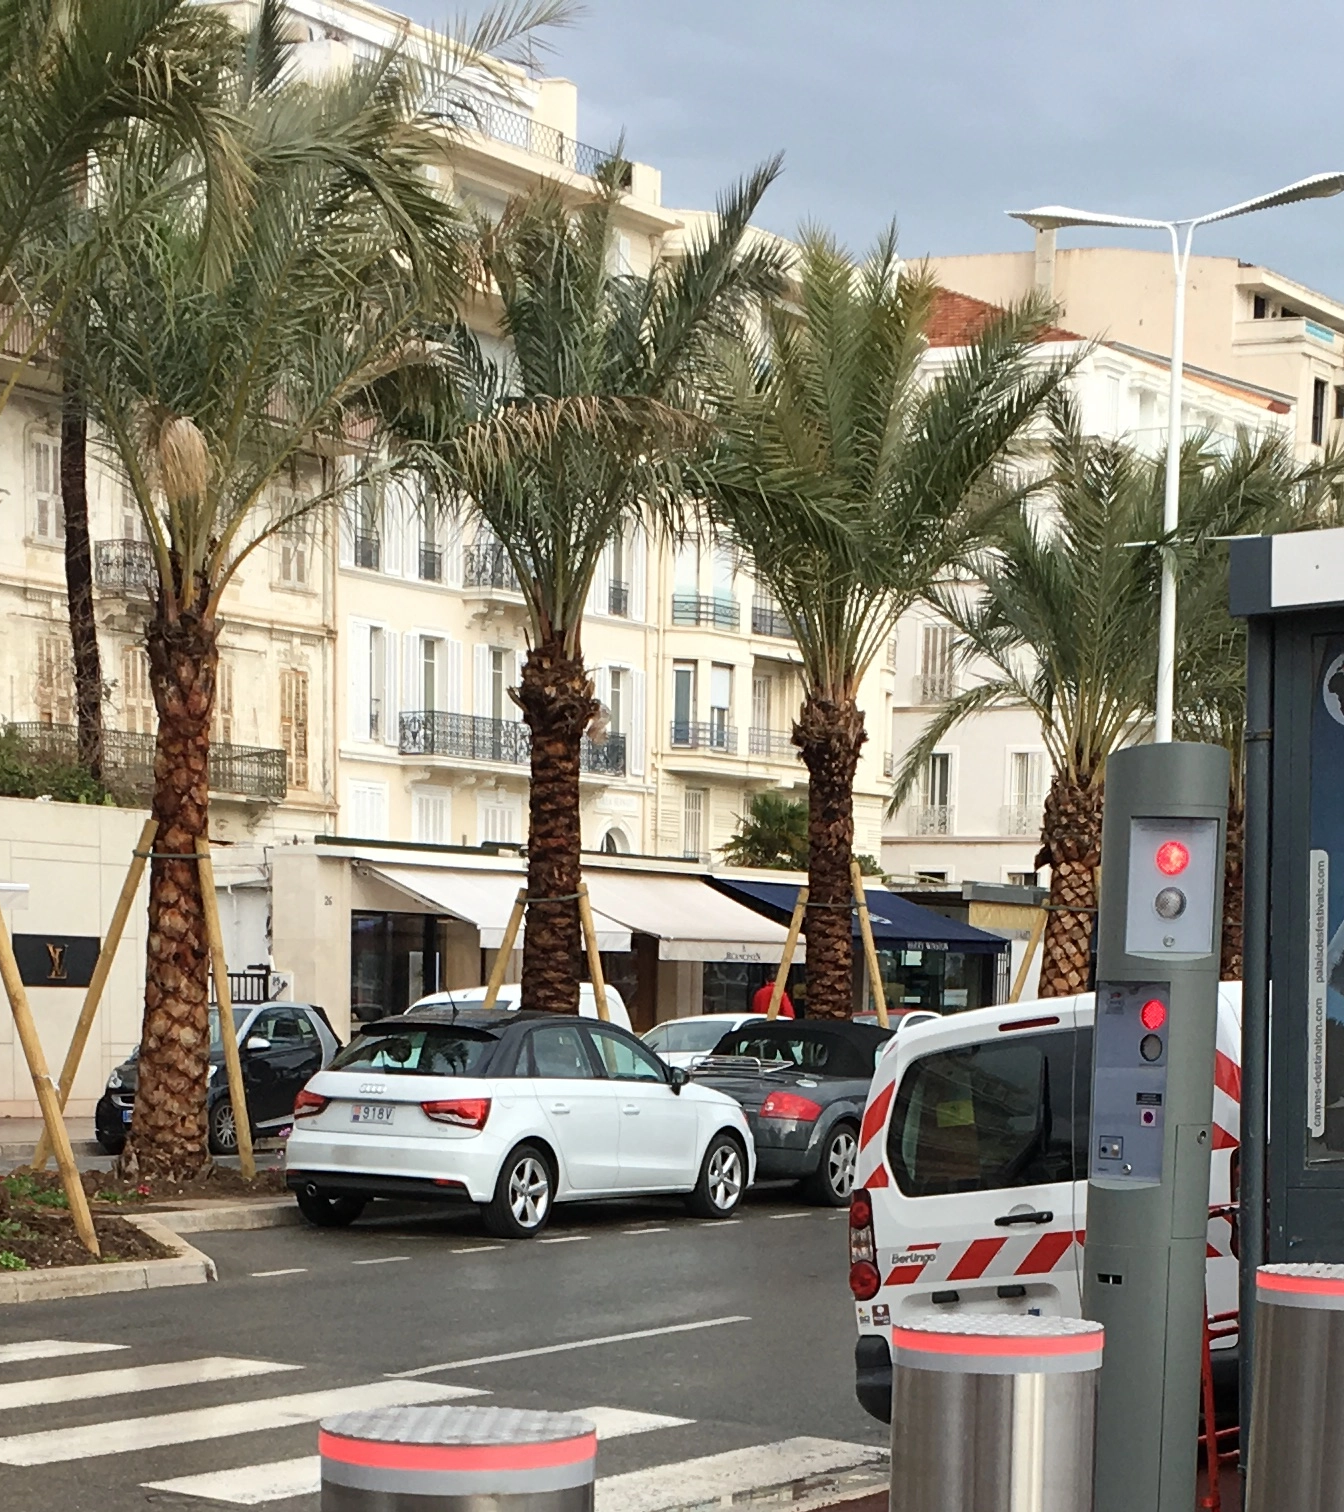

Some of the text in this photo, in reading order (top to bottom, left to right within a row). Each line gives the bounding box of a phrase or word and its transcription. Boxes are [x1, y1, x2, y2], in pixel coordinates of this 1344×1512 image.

[1313, 997, 1323, 1128] cannes-destination.com
[362, 1107, 393, 1120] 918V
[891, 1252, 937, 1265] Berlingo
